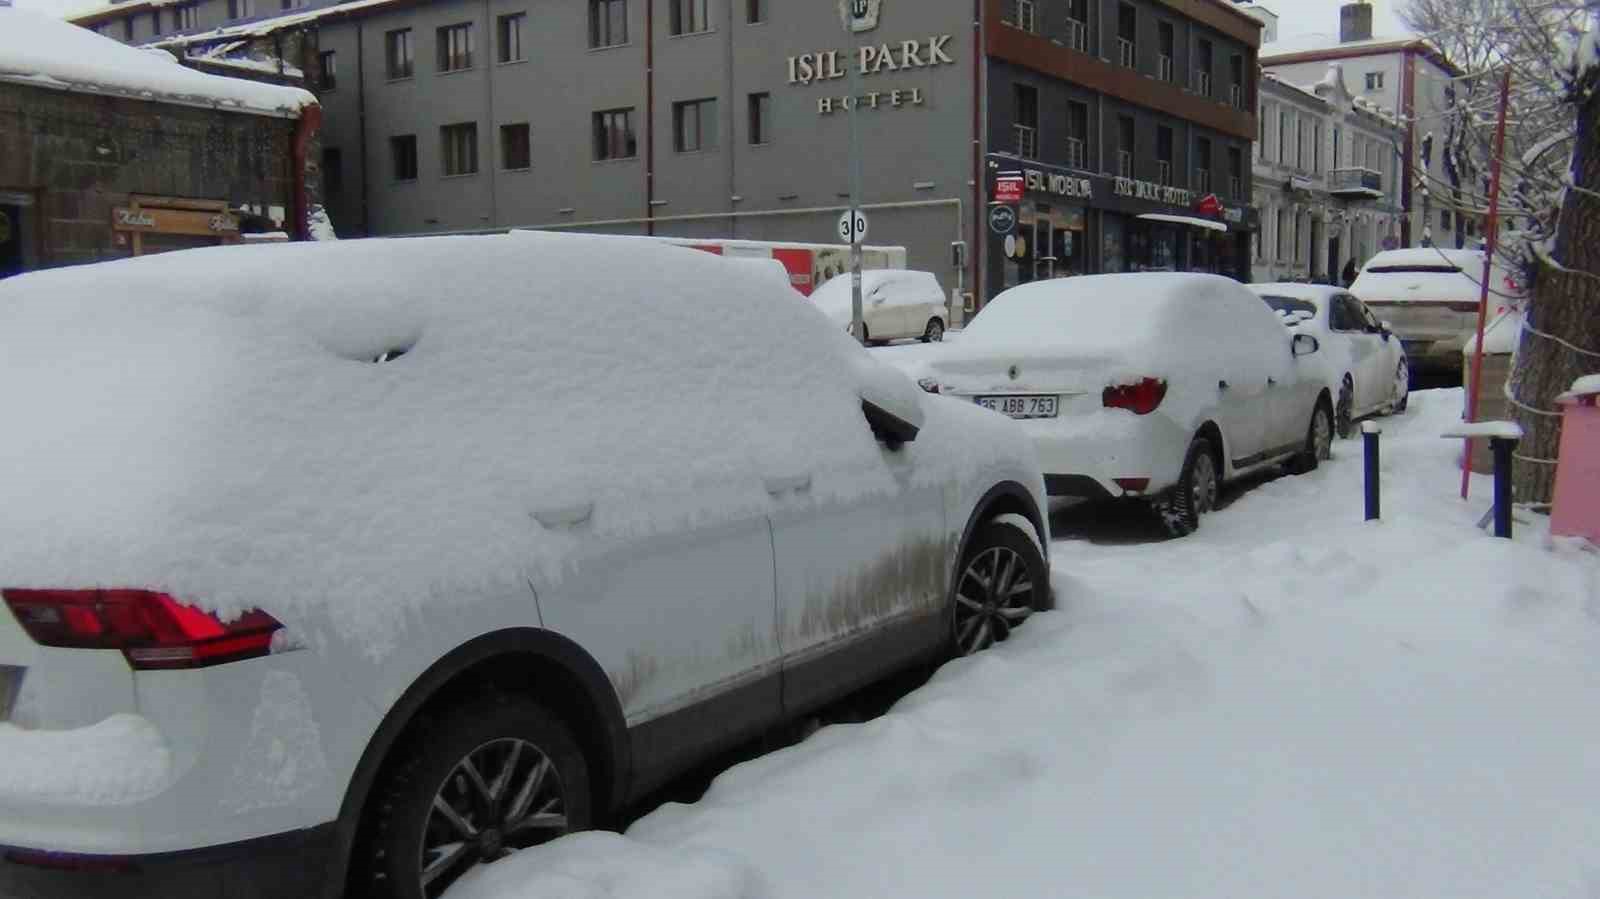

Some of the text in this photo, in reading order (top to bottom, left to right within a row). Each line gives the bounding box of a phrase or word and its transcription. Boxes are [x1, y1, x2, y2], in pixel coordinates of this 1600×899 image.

[787, 35, 953, 84] IŞIL PARK
[817, 88, 923, 114] HOTEL
[1002, 399, 1025, 413] ABB
[1030, 399, 1054, 413] 763
